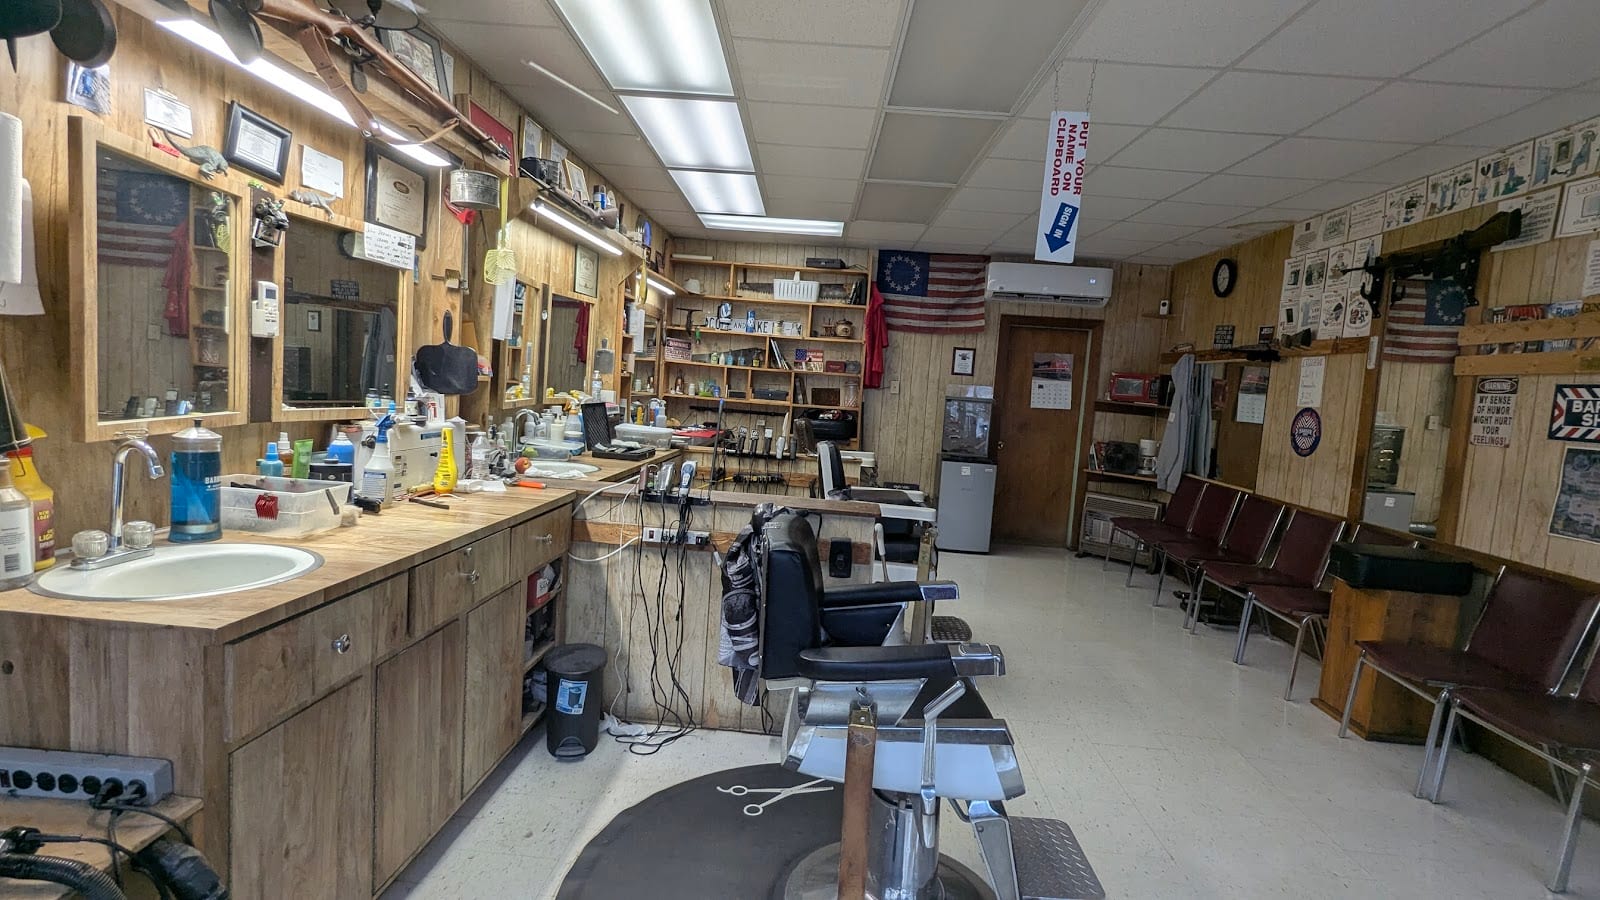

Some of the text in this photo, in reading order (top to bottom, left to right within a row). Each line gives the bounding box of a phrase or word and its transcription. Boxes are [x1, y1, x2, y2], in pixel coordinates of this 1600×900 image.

[1051, 118, 1066, 196] CLIPBOARD
[1062, 124, 1078, 191] NAME ON
[1073, 121, 1089, 195] PUT YOUR
[1053, 206, 1073, 239] SIGN IN
[1479, 395, 1512, 404] MY SENSE
[1476, 405, 1510, 415] OF HUMOR
[1473, 416, 1512, 425] MIGHT HURT
[1482, 426, 1499, 434] YOUR
[1473, 435, 1507, 446] FEELINGS!
